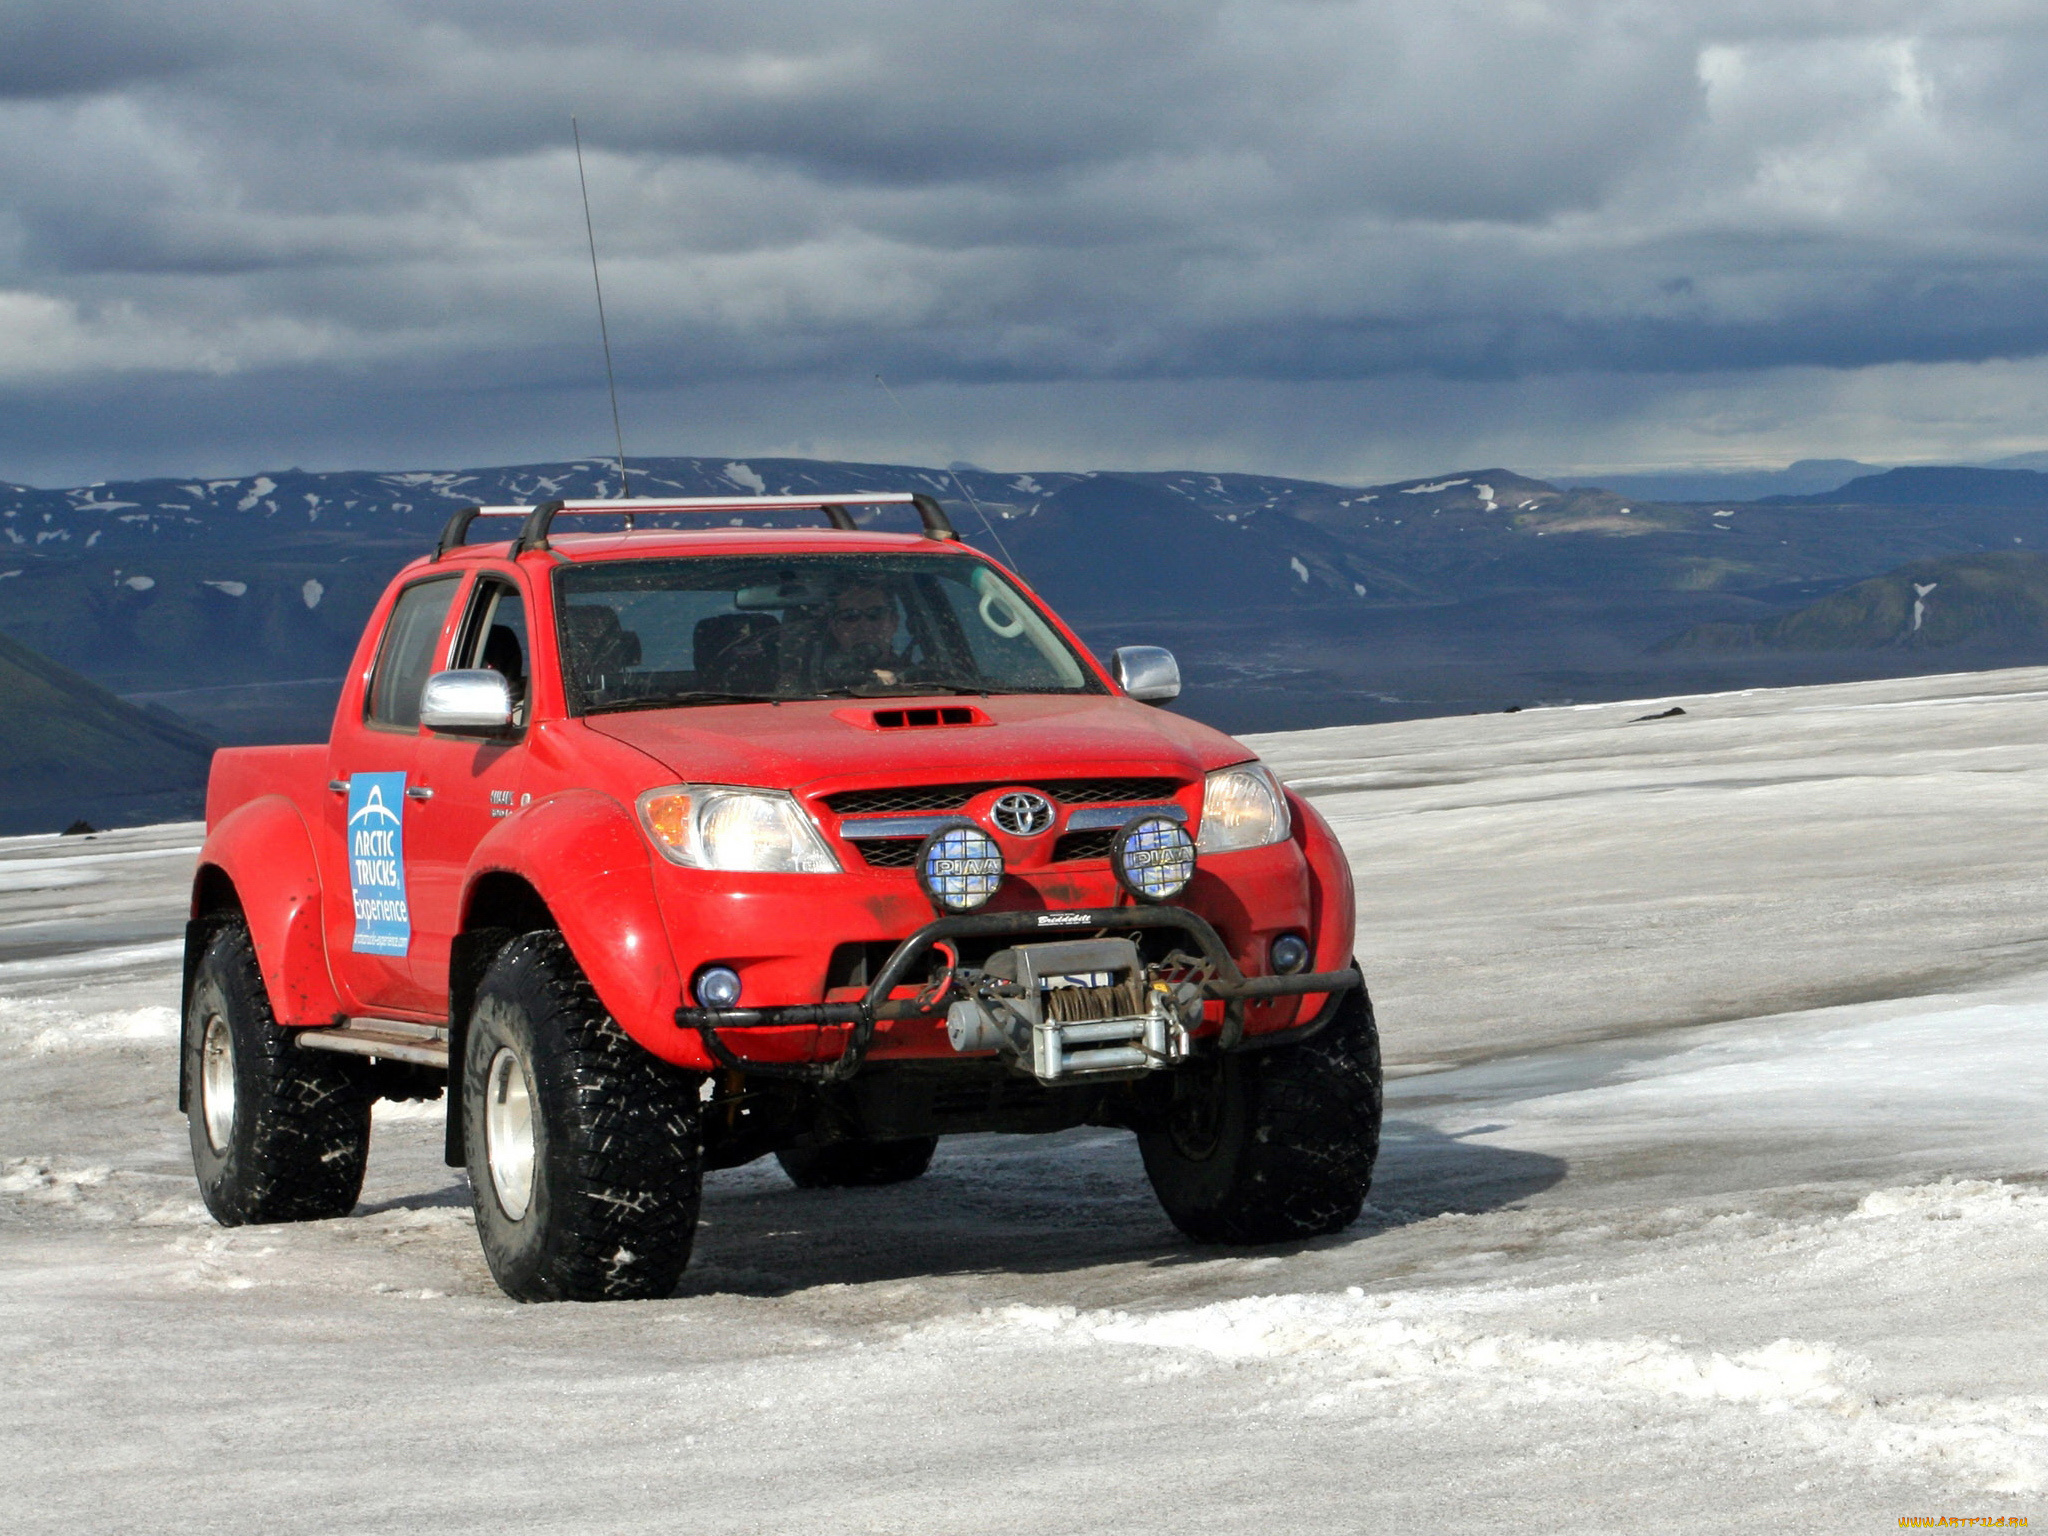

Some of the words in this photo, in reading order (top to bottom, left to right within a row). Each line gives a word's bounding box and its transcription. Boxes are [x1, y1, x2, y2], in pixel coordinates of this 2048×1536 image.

[355, 830, 395, 857] ARCTIC
[1133, 846, 1192, 866] PIAA
[355, 859, 397, 887] TRUCKS
[936, 858, 1000, 876] PIAA
[352, 889, 408, 930] Experience
